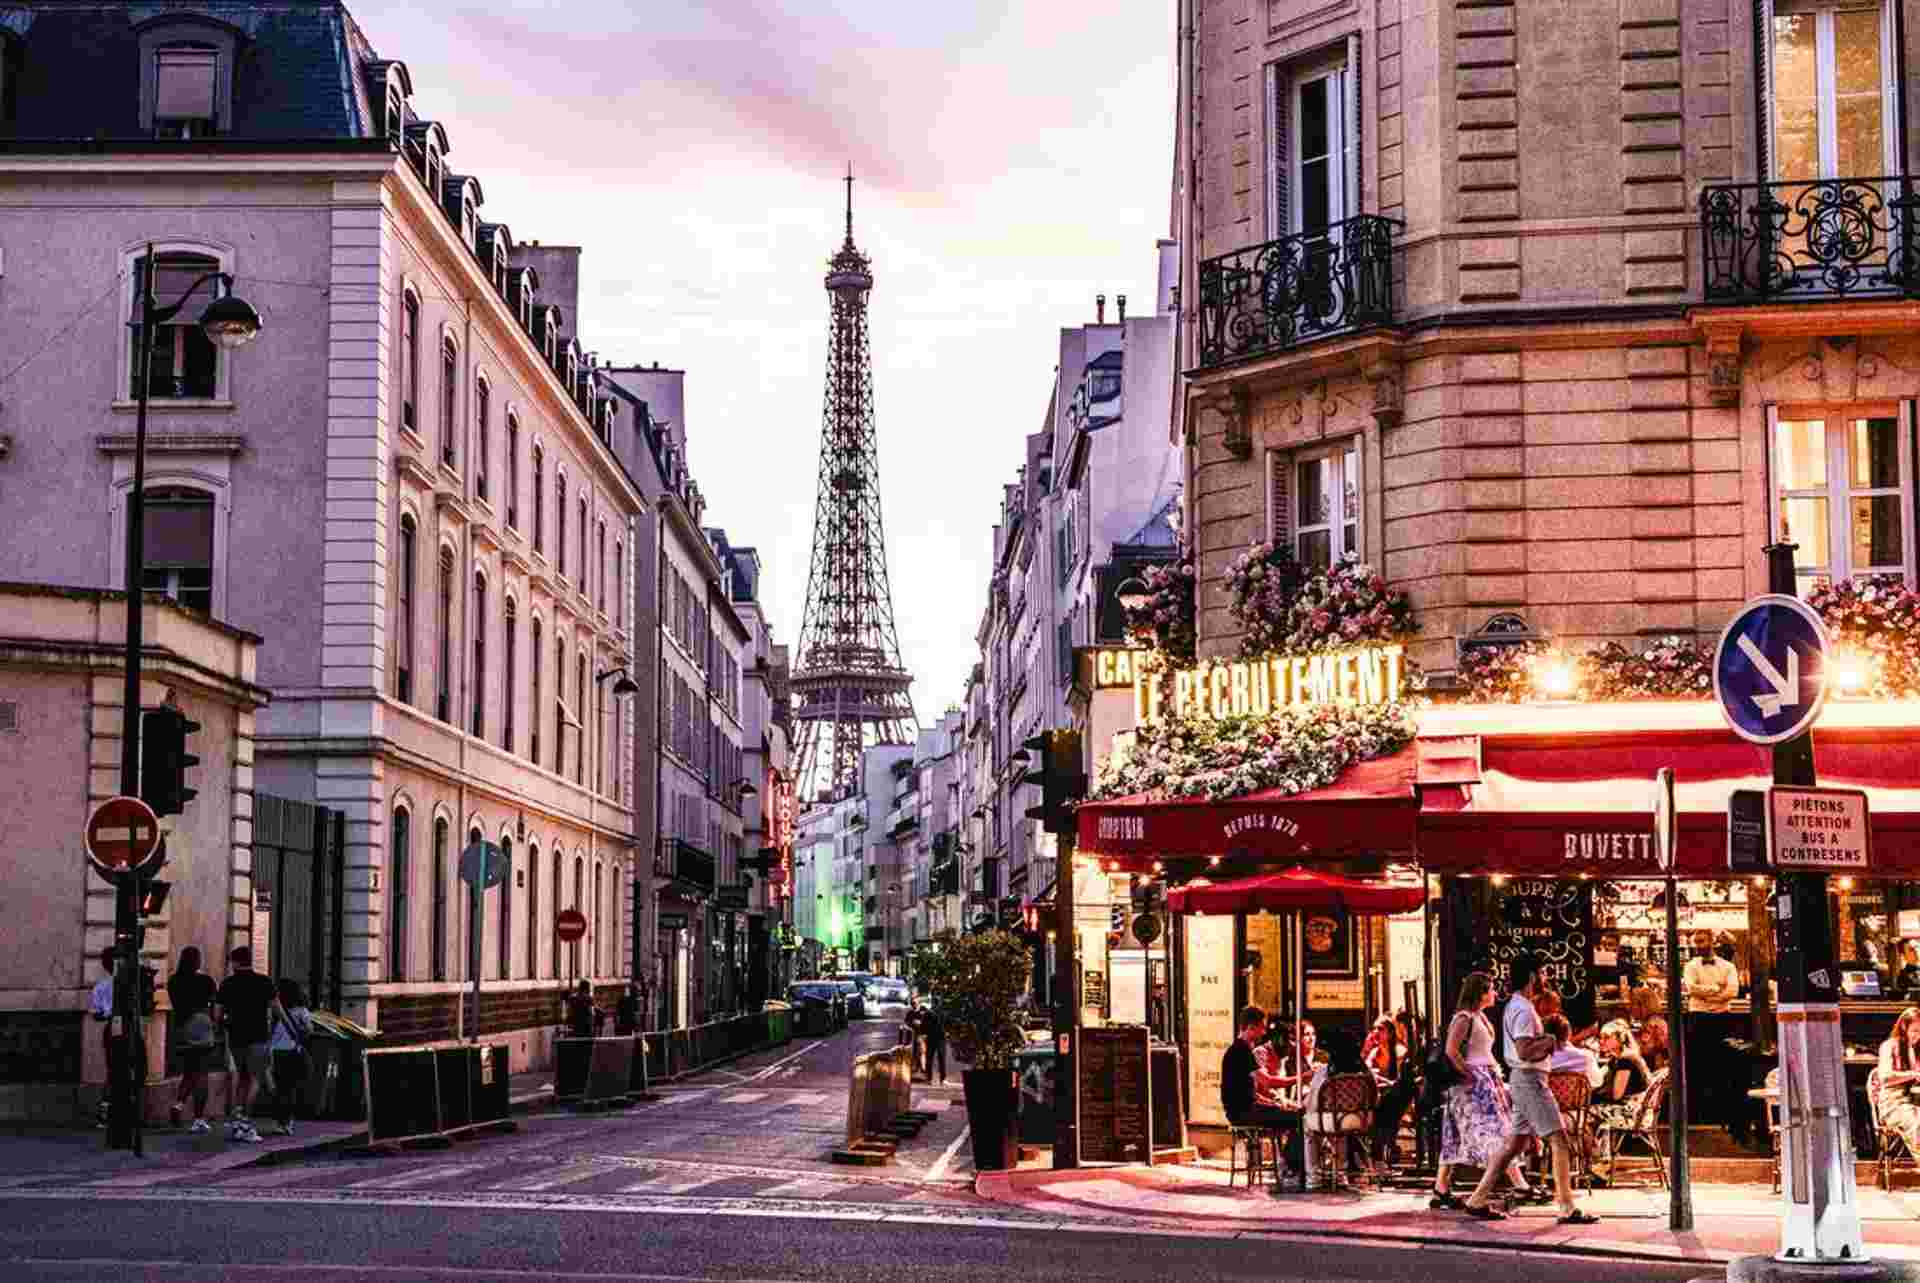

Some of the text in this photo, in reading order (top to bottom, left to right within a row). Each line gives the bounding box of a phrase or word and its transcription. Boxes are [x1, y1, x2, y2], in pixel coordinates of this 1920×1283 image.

[1097, 650, 1152, 684] CAF
[1175, 645, 1402, 720] RECRUTEMENT
[1223, 813, 1265, 838] DEPUIS
[1786, 815, 1851, 829] ATTENTION
[1564, 832, 1657, 860] BUVETT
[1801, 831, 1825, 845] BUS
[1781, 847, 1861, 862] CONTRESENS
